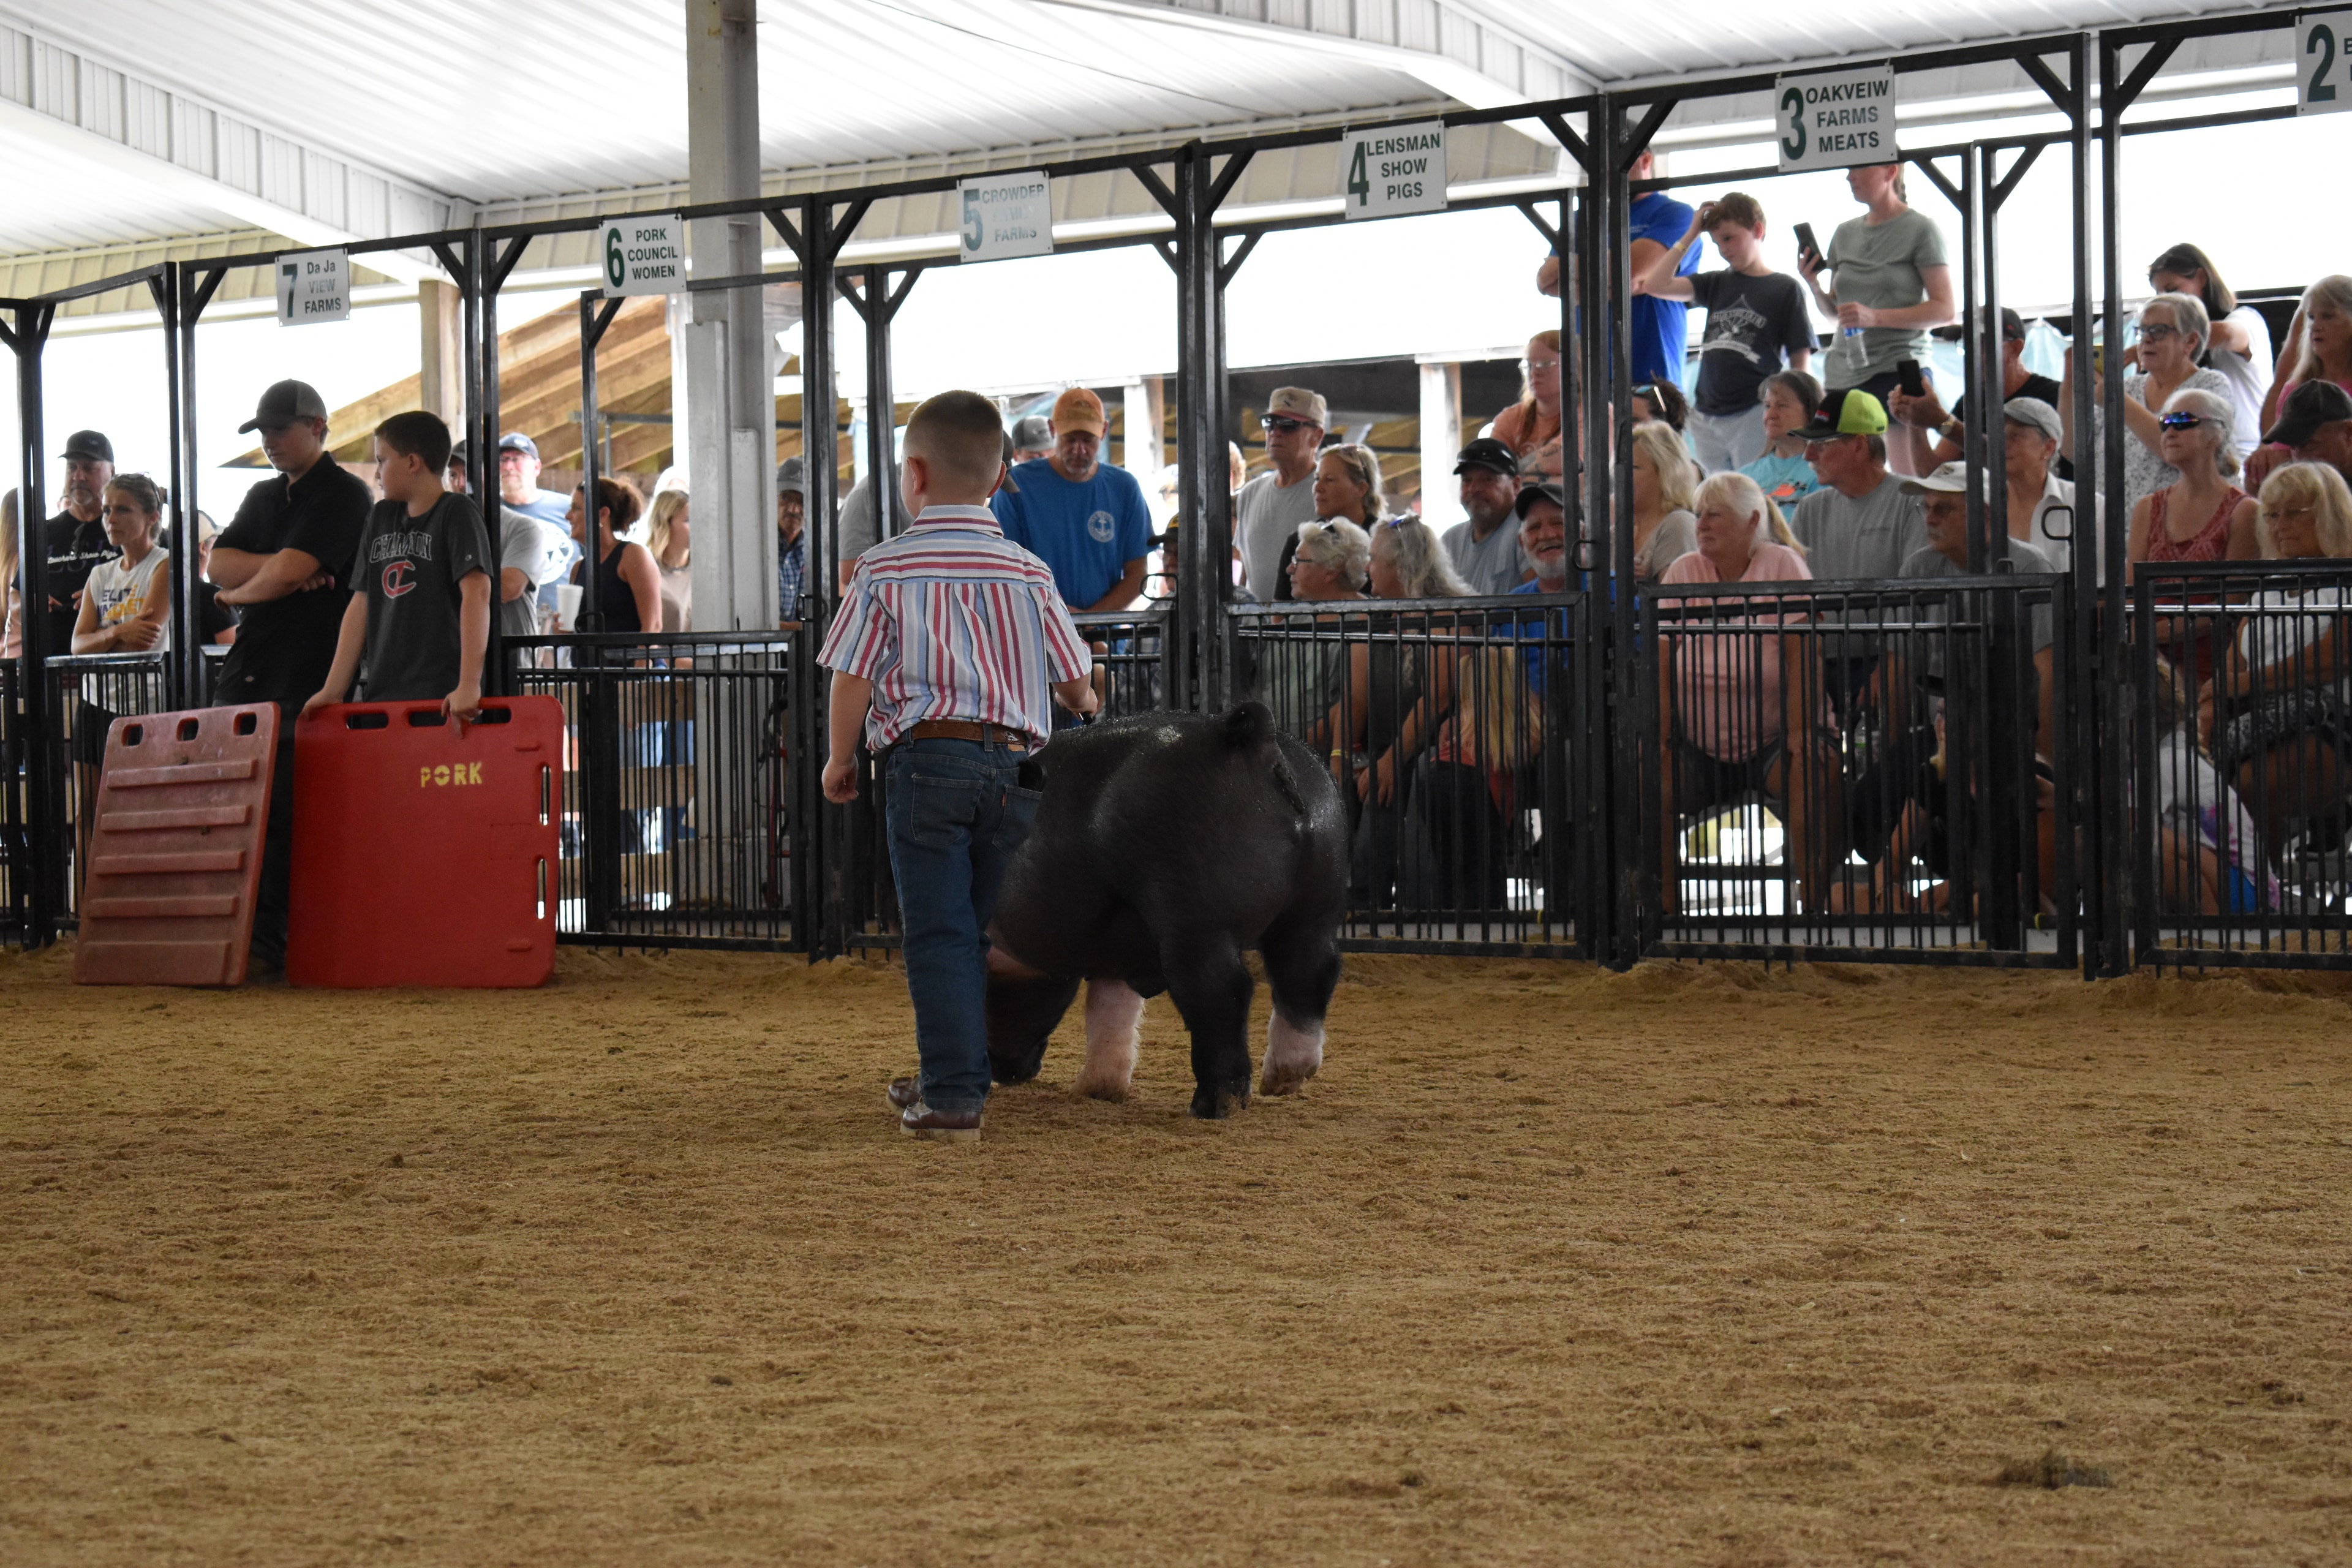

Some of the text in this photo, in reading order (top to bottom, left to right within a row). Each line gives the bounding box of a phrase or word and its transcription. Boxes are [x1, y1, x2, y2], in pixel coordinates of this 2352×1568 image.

[2306, 23, 2336, 102] 2
[1806, 80, 1889, 105] OAKVEIW
[1781, 86, 1807, 160] 3
[1817, 106, 1879, 128] FARMS
[1366, 132, 1441, 157] LENSMAN
[1819, 130, 1880, 153] MEATS
[1348, 141, 1370, 206] 4
[1381, 157, 1428, 178] SHOW
[1387, 181, 1423, 200] PIGS
[963, 188, 983, 252] 5
[636, 228, 667, 243] PORK
[994, 226, 1037, 243] FARMS
[606, 227, 625, 288] 6
[628, 246, 678, 262] COUNCIL
[632, 265, 676, 280] WOMEN
[282, 263, 298, 318] 7
[308, 278, 336, 294] VIEW
[304, 298, 342, 314] FARMS
[421, 761, 483, 788] PORK
